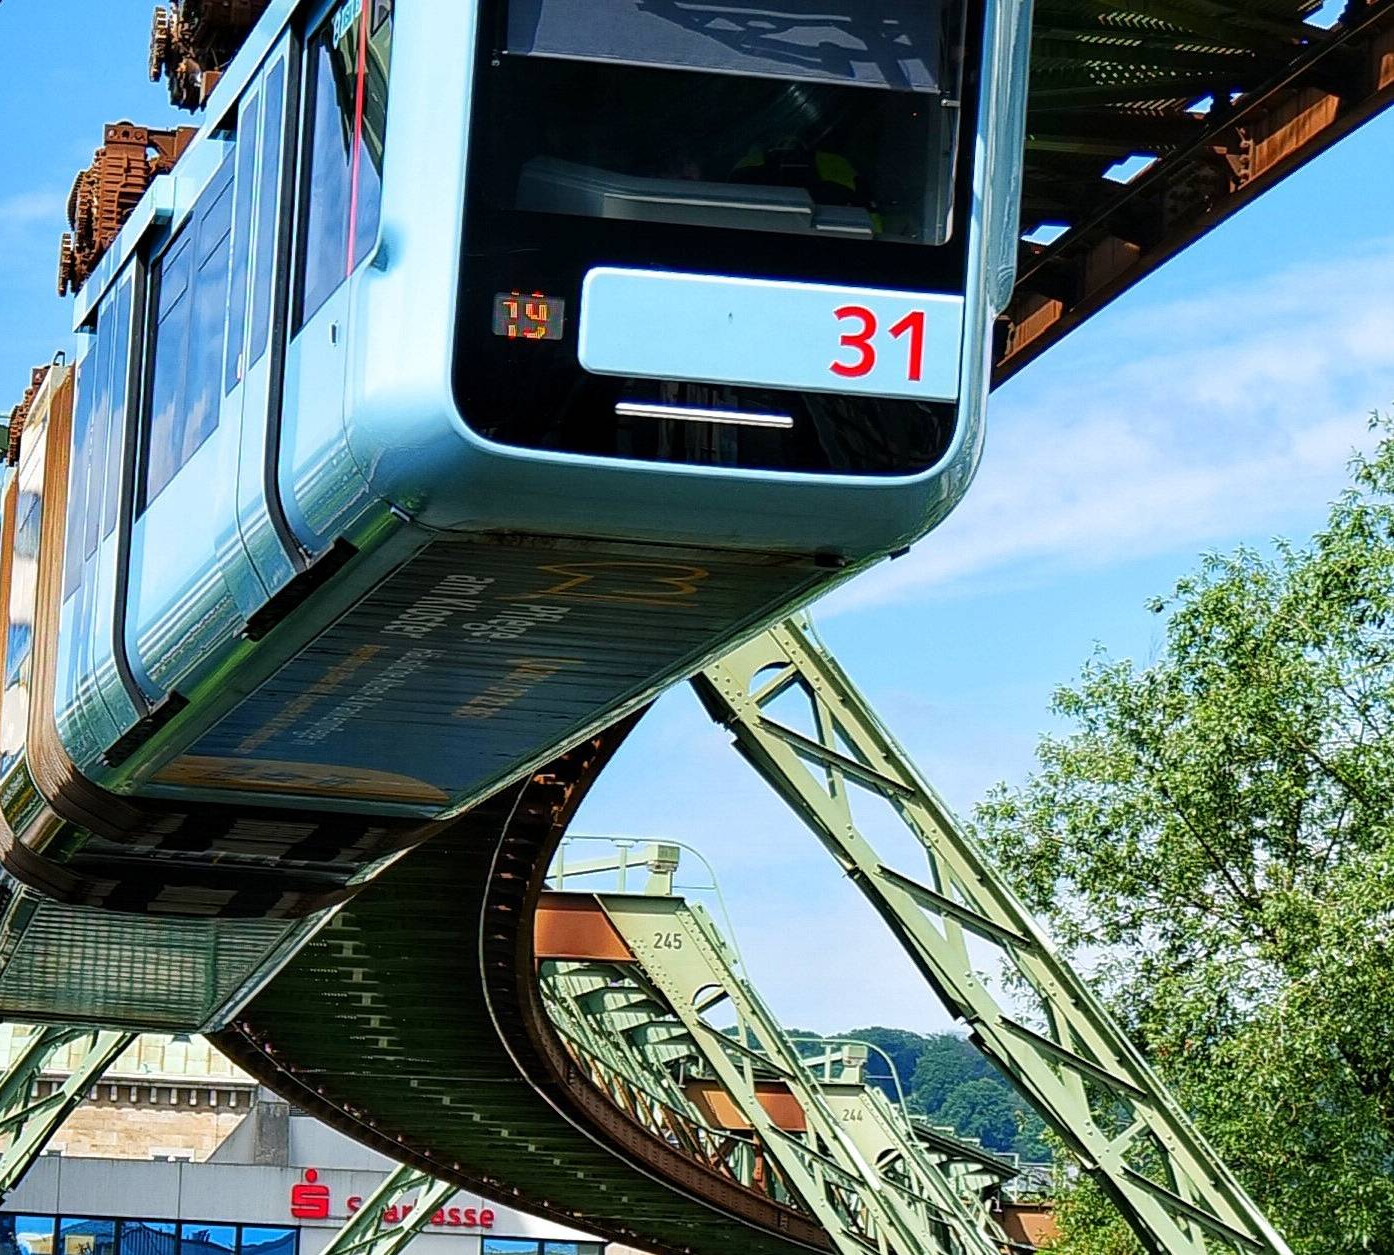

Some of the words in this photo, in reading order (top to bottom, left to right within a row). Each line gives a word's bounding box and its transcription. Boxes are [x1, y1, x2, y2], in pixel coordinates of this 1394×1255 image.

[828, 305, 926, 382] 31
[430, 574, 496, 596] am
[379, 596, 482, 639] Kloster
[462, 603, 572, 640] Pflege
[653, 931, 683, 950] 245
[842, 1108, 863, 1121] 244
[346, 1195, 495, 1229] sarasse
